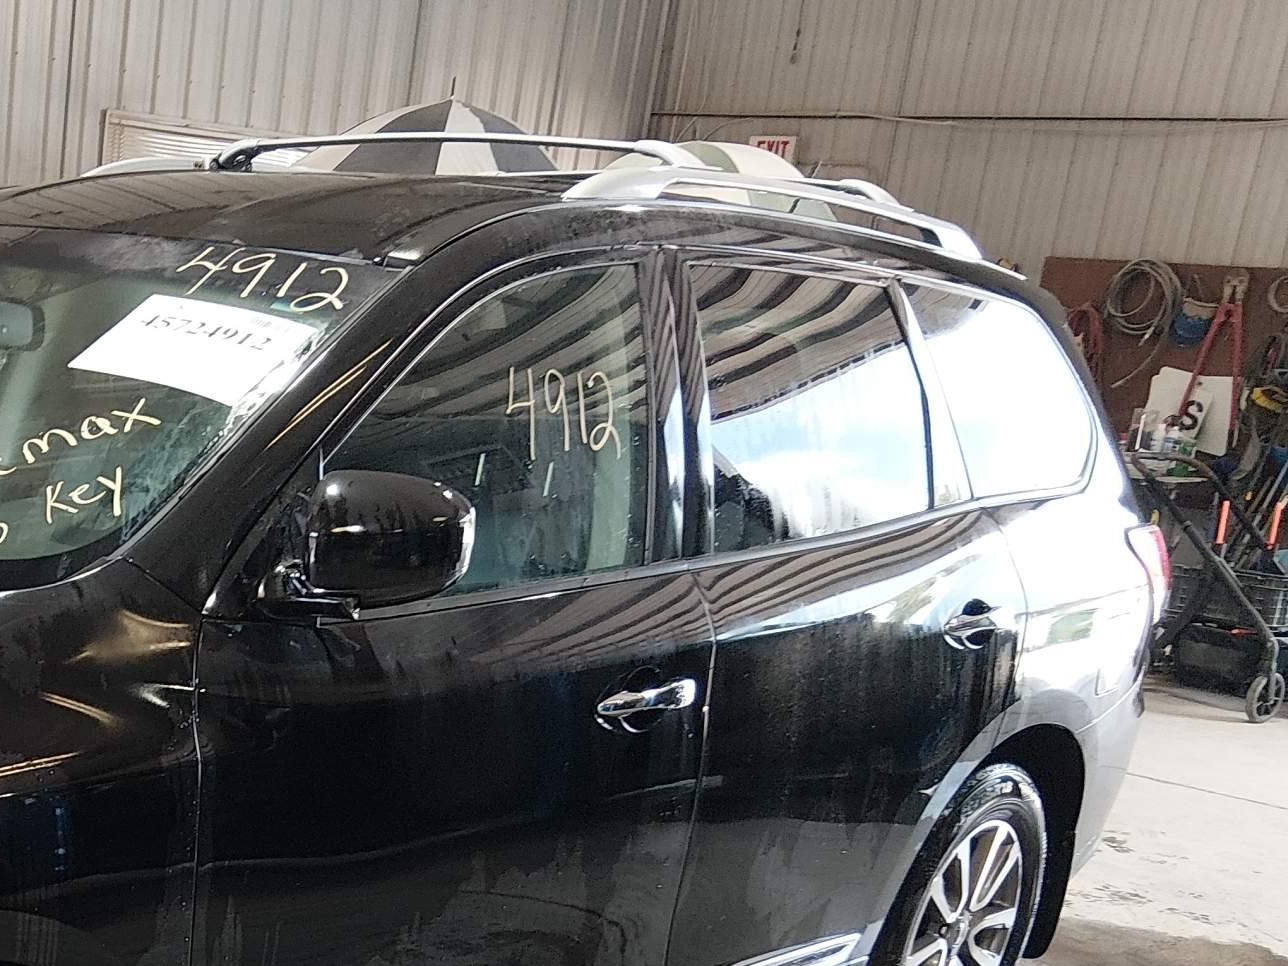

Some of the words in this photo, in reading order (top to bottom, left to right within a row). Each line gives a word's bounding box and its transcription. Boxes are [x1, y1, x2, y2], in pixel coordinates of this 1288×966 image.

[175, 246, 349, 313] 4912
[140, 314, 273, 351] 45724912
[505, 366, 621, 461] 4912
